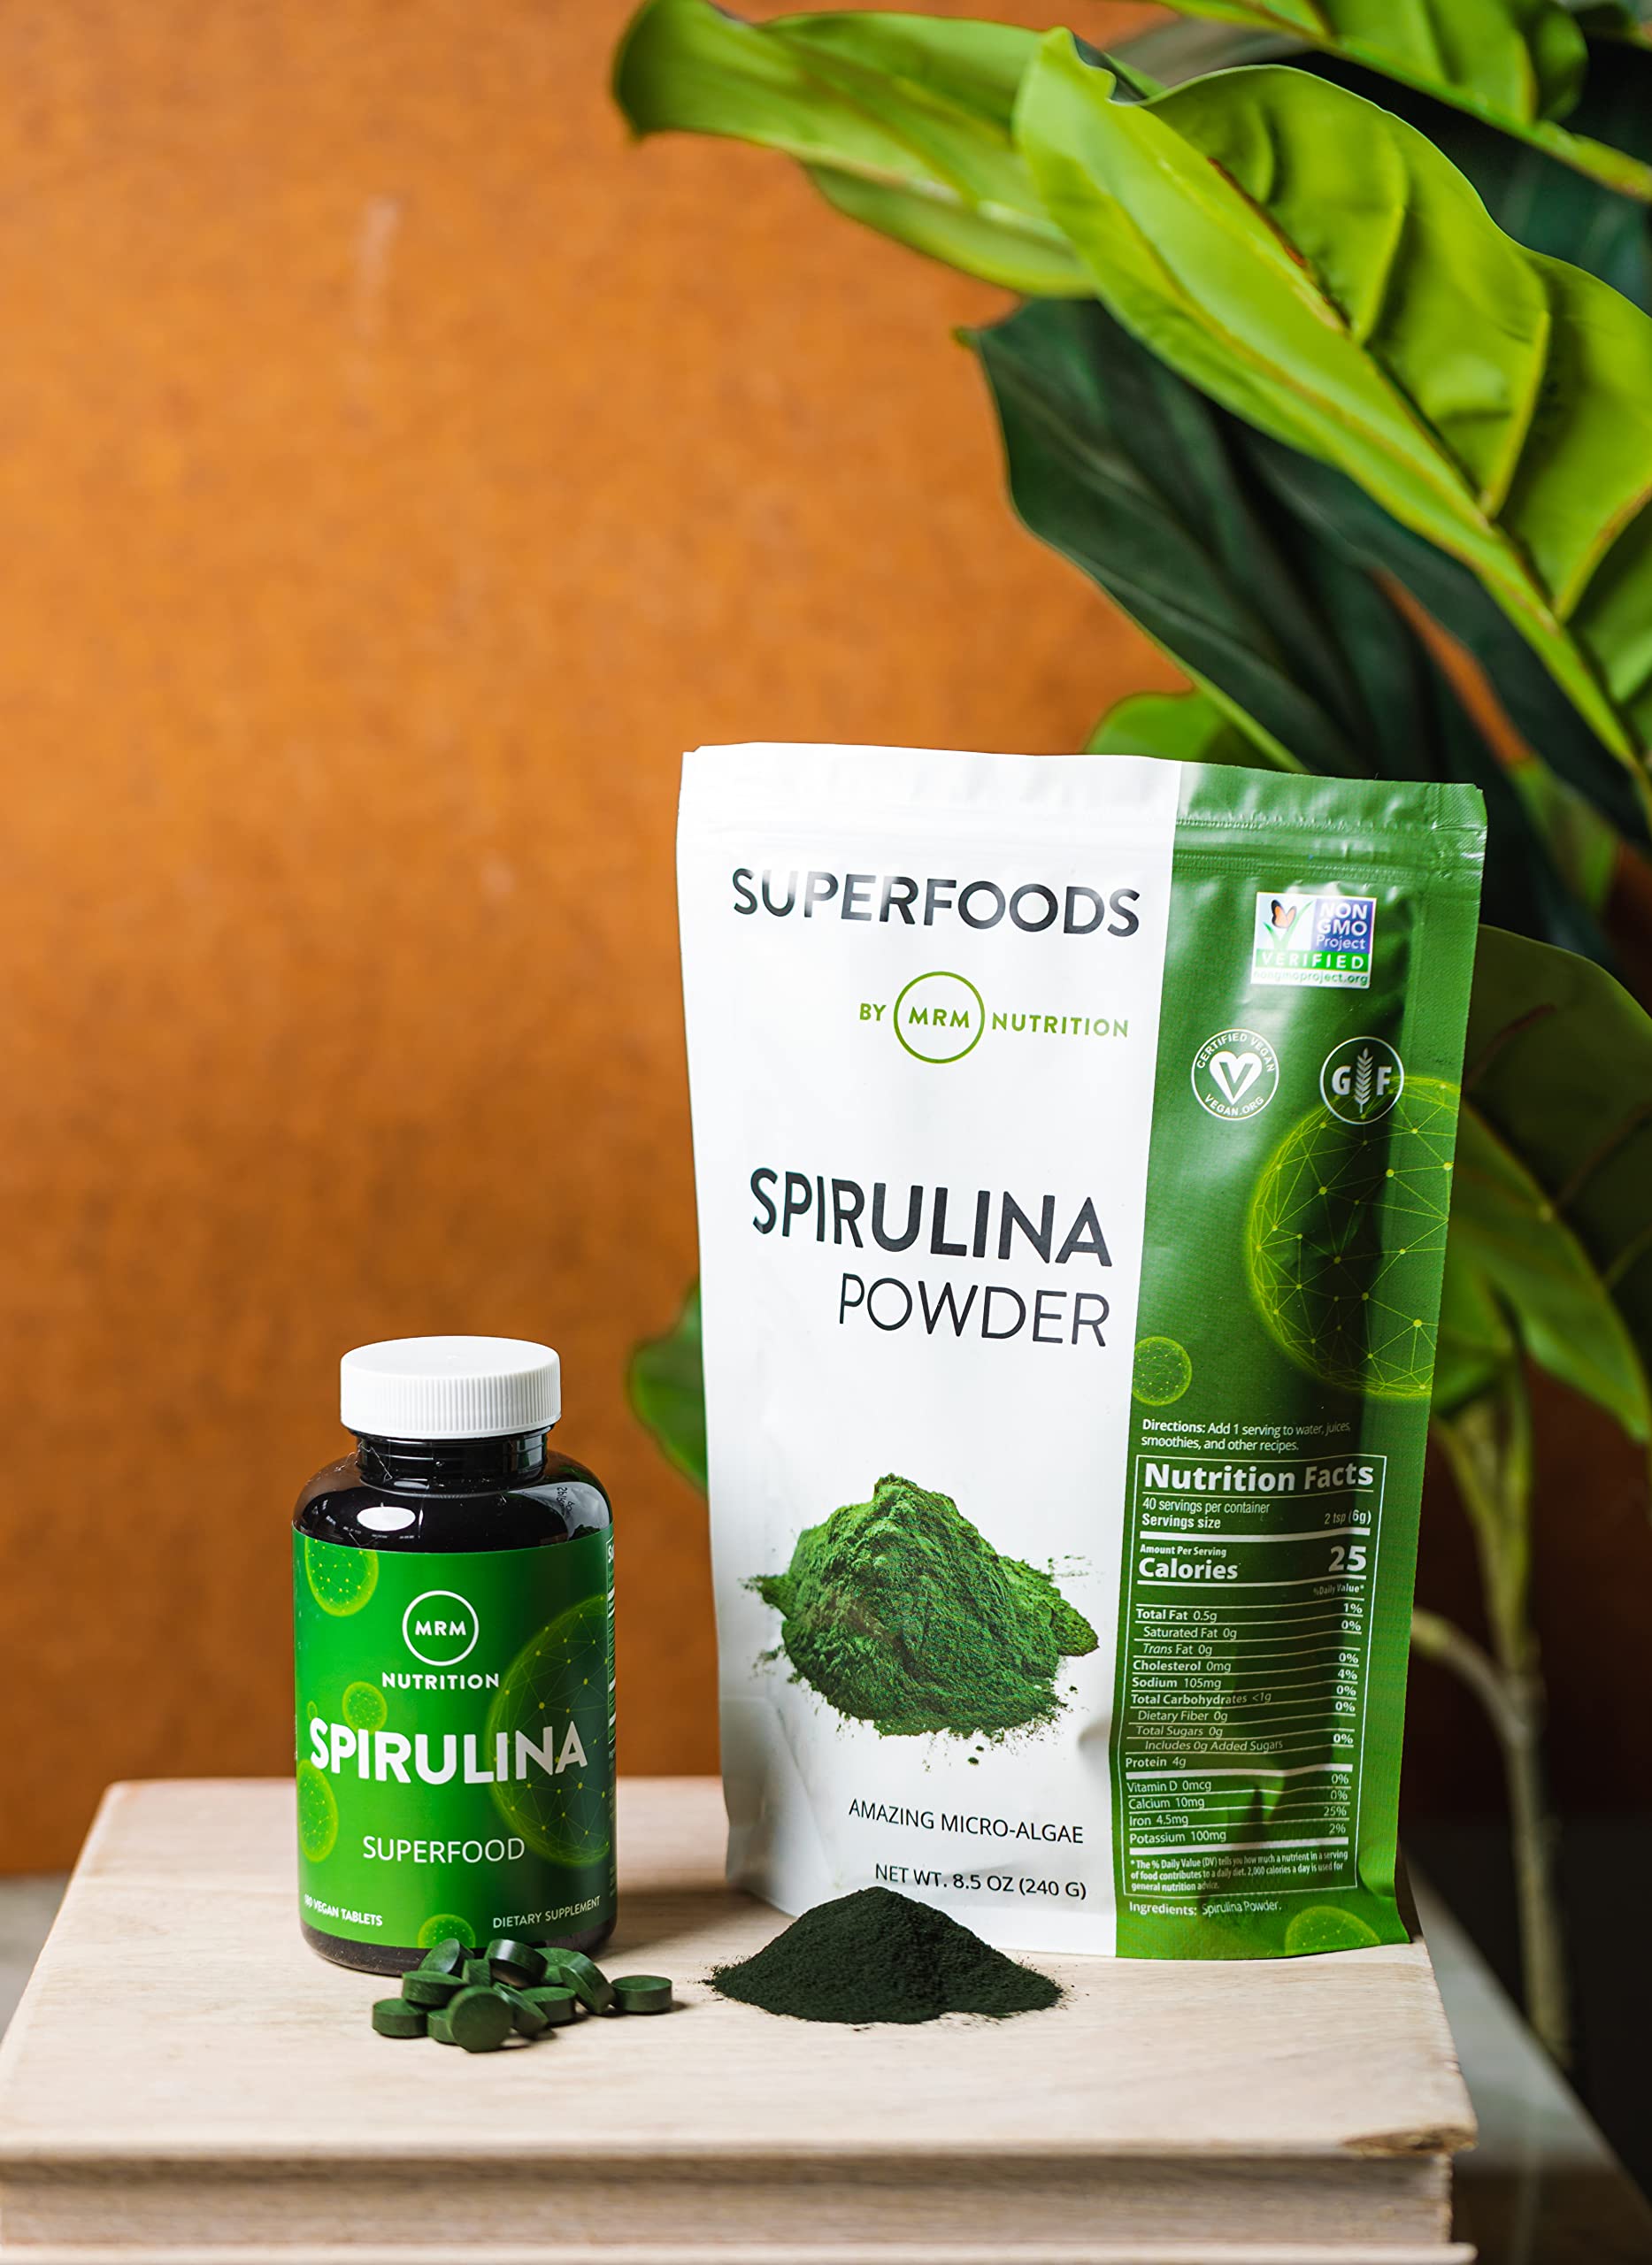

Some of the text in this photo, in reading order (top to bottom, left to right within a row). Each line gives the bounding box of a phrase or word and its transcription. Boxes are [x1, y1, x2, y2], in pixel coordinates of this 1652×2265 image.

[732, 868, 1141, 937] SUPERFOODS
[1320, 902, 1367, 919] NON
[1318, 918, 1367, 936] GMO
[1317, 934, 1365, 951] Project
[1262, 953, 1364, 970] VERIFIED
[859, 1003, 1129, 1038] BY MRM NUTRITION
[1196, 1033, 1276, 1072] CERTIFIED VEGAN
[1332, 1065, 1392, 1095] G F
[1204, 1094, 1264, 1116] VEGAN.ORG
[750, 1167, 1112, 1267] SPIRULINA
[840, 1272, 1110, 1347] POWDER
[1142, 1419, 1205, 1432] Directions:
[1208, 1423, 1230, 1434] Add
[1233, 1424, 1238, 1434] 1
[1242, 1424, 1280, 1439] serving
[1283, 1425, 1293, 1436] to
[1295, 1424, 1324, 1436] water,
[1141, 1436, 1298, 1454] smoothies, and other recipes.
[1144, 1463, 1373, 1492] Nutrition Facts
[1142, 1497, 1270, 1515] 40 servings per container
[1141, 1513, 1221, 1531] Servings size
[1325, 1509, 1372, 1524] 2 tsp (6g)
[1140, 1544, 1226, 1557] Amount Per Serving
[1328, 1546, 1366, 1571] 25
[1138, 1557, 1238, 1579] Calories
[1136, 1609, 1218, 1623] Total Fat 0.5g
[1343, 1603, 1363, 1614] 1%
[415, 1621, 466, 1636] MRM
[1143, 1626, 1237, 1640] Saturated Fat 0g
[1341, 1620, 1361, 1632] 0%
[1142, 1643, 1212, 1657] Trans Fat 0g
[1339, 1653, 1358, 1664] 0%
[1133, 1661, 1232, 1674] Cholesterol 0mg
[1338, 1669, 1357, 1680] 4%
[381, 1672, 500, 1690] NUTRITION
[1132, 1678, 1221, 1690] Sodium 105mg
[1336, 1685, 1356, 1696] 0%
[1132, 1692, 1272, 1708] Total Carbohydrates <1g
[1335, 1701, 1355, 1712] 0%
[1138, 1710, 1227, 1724] Dietary Fiber 0g
[1137, 1726, 1223, 1738] Total Sugars 0g
[1333, 1733, 1353, 1745] 0%
[309, 1716, 588, 1785] SPIRULINA
[1145, 1740, 1283, 1753] Includes 0g Added Sugars
[1126, 1757, 1186, 1769] Protein 4g
[1126, 1780, 1211, 1793] Vitamin D 0mcg
[1332, 1774, 1348, 1785] 0%
[1128, 1797, 1204, 1809] Calcium 10mg
[1331, 1790, 1348, 1800] 0%
[1324, 1806, 1347, 1817] 25%
[849, 1799, 1083, 1843] AMAZING MICRO-ALGAE
[1129, 1814, 1188, 1826] Iron 4.5mg
[1329, 1823, 1346, 1834] 2%
[1129, 1831, 1226, 1844] Potassium 100mg
[363, 1835, 525, 1863] SUPERFOOD
[1136, 1860, 1150, 1870] The
[1152, 1861, 1159, 1870] %
[1161, 1860, 1179, 1870] Daily
[1203, 1857, 1218, 1868] (DV)
[1282, 1853, 1309, 1862] nutrient
[1324, 1850, 1348, 1860] serving
[1141, 1870, 1157, 1880] food
[1159, 1870, 1202, 1880] contributes
[1248, 1867, 1264, 1876] 2,000
[1266, 1865, 1291, 1875] calories
[1298, 1863, 1310, 1874] day
[875, 1863, 1087, 1900] NET WT. 8.5 OZ (240 G)
[1162, 1882, 1195, 1891] nutrition
[313, 1899, 339, 1917] VEGAN
[342, 1908, 382, 1926] TABLETS
[493, 1895, 600, 1928] DIETARY SUPPLEMENT
[1130, 1900, 1281, 1916] Ingredients: Spirulina Powder.
